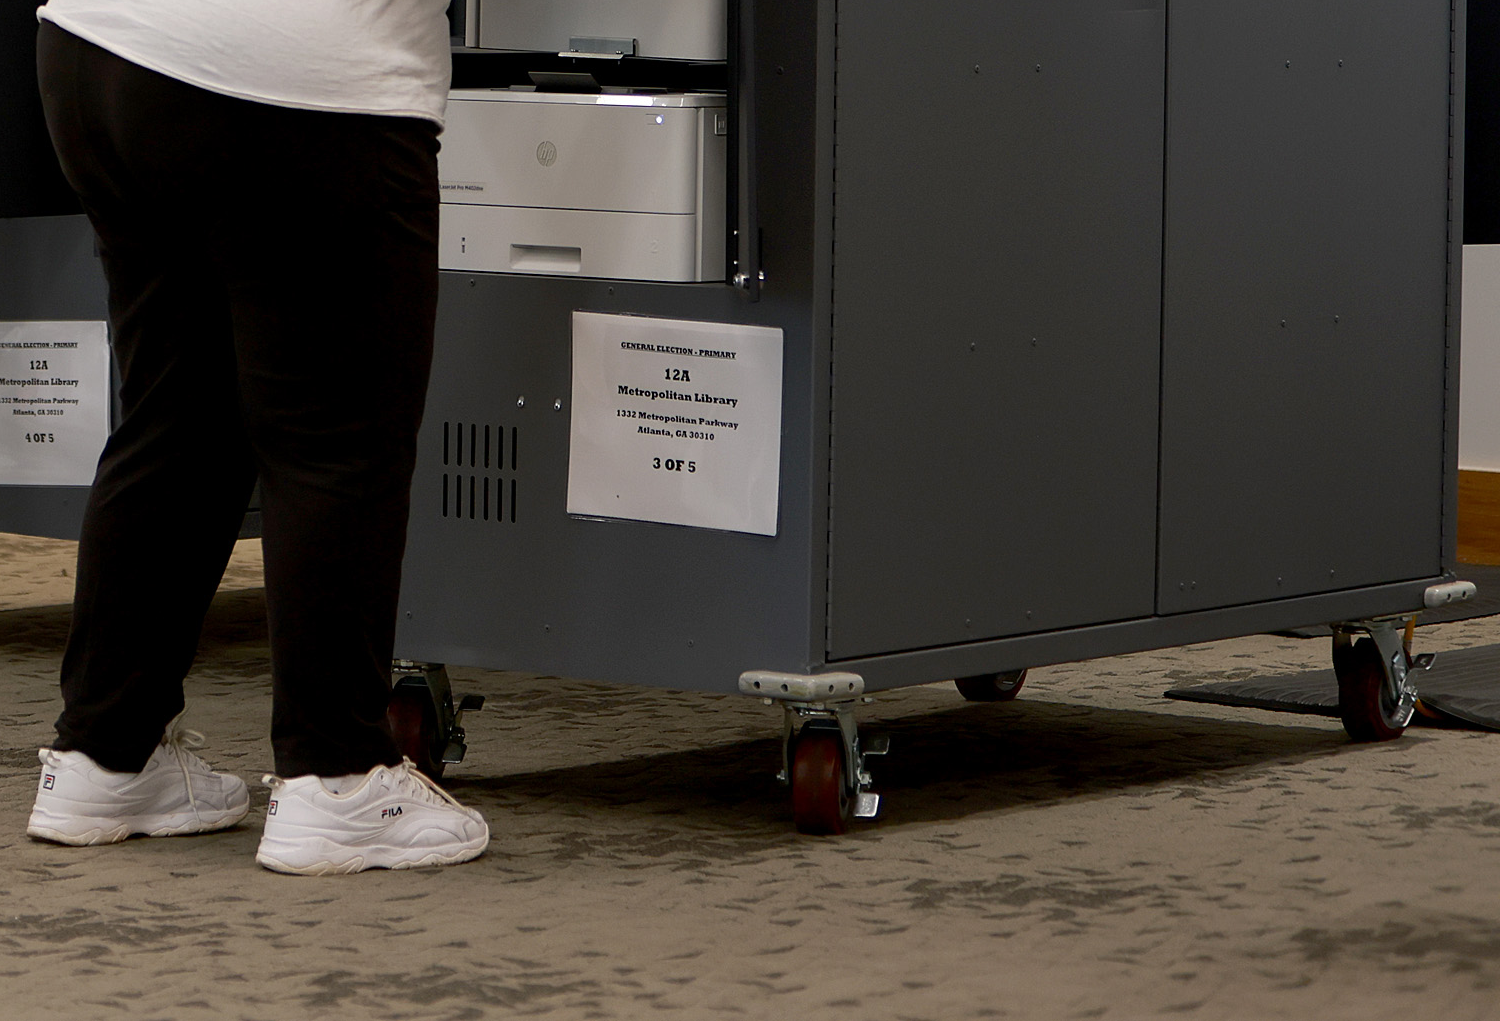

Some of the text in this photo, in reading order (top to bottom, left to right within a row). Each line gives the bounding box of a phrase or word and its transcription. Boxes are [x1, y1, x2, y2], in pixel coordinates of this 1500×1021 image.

[536, 140, 558, 167] hp
[620, 341, 737, 360] GENERAL ELECTION PRIMARY
[29, 360, 49, 370] 12A
[664, 368, 691, 382] 12A
[51, 378, 79, 387] Library
[12, 397, 52, 405] Metropolitan
[52, 397, 79, 405] Parkway
[617, 385, 738, 408] Metropolitan Library
[12, 409, 36, 417] Atlanta,
[616, 409, 739, 430] 1332 Metropolitan Parkway
[25, 433, 54, 443] 4 OF 5
[637, 426, 715, 441] Atlanta, GA 30310
[652, 457, 696, 473] 3 OF 5
[381, 806, 403, 819] FILA
